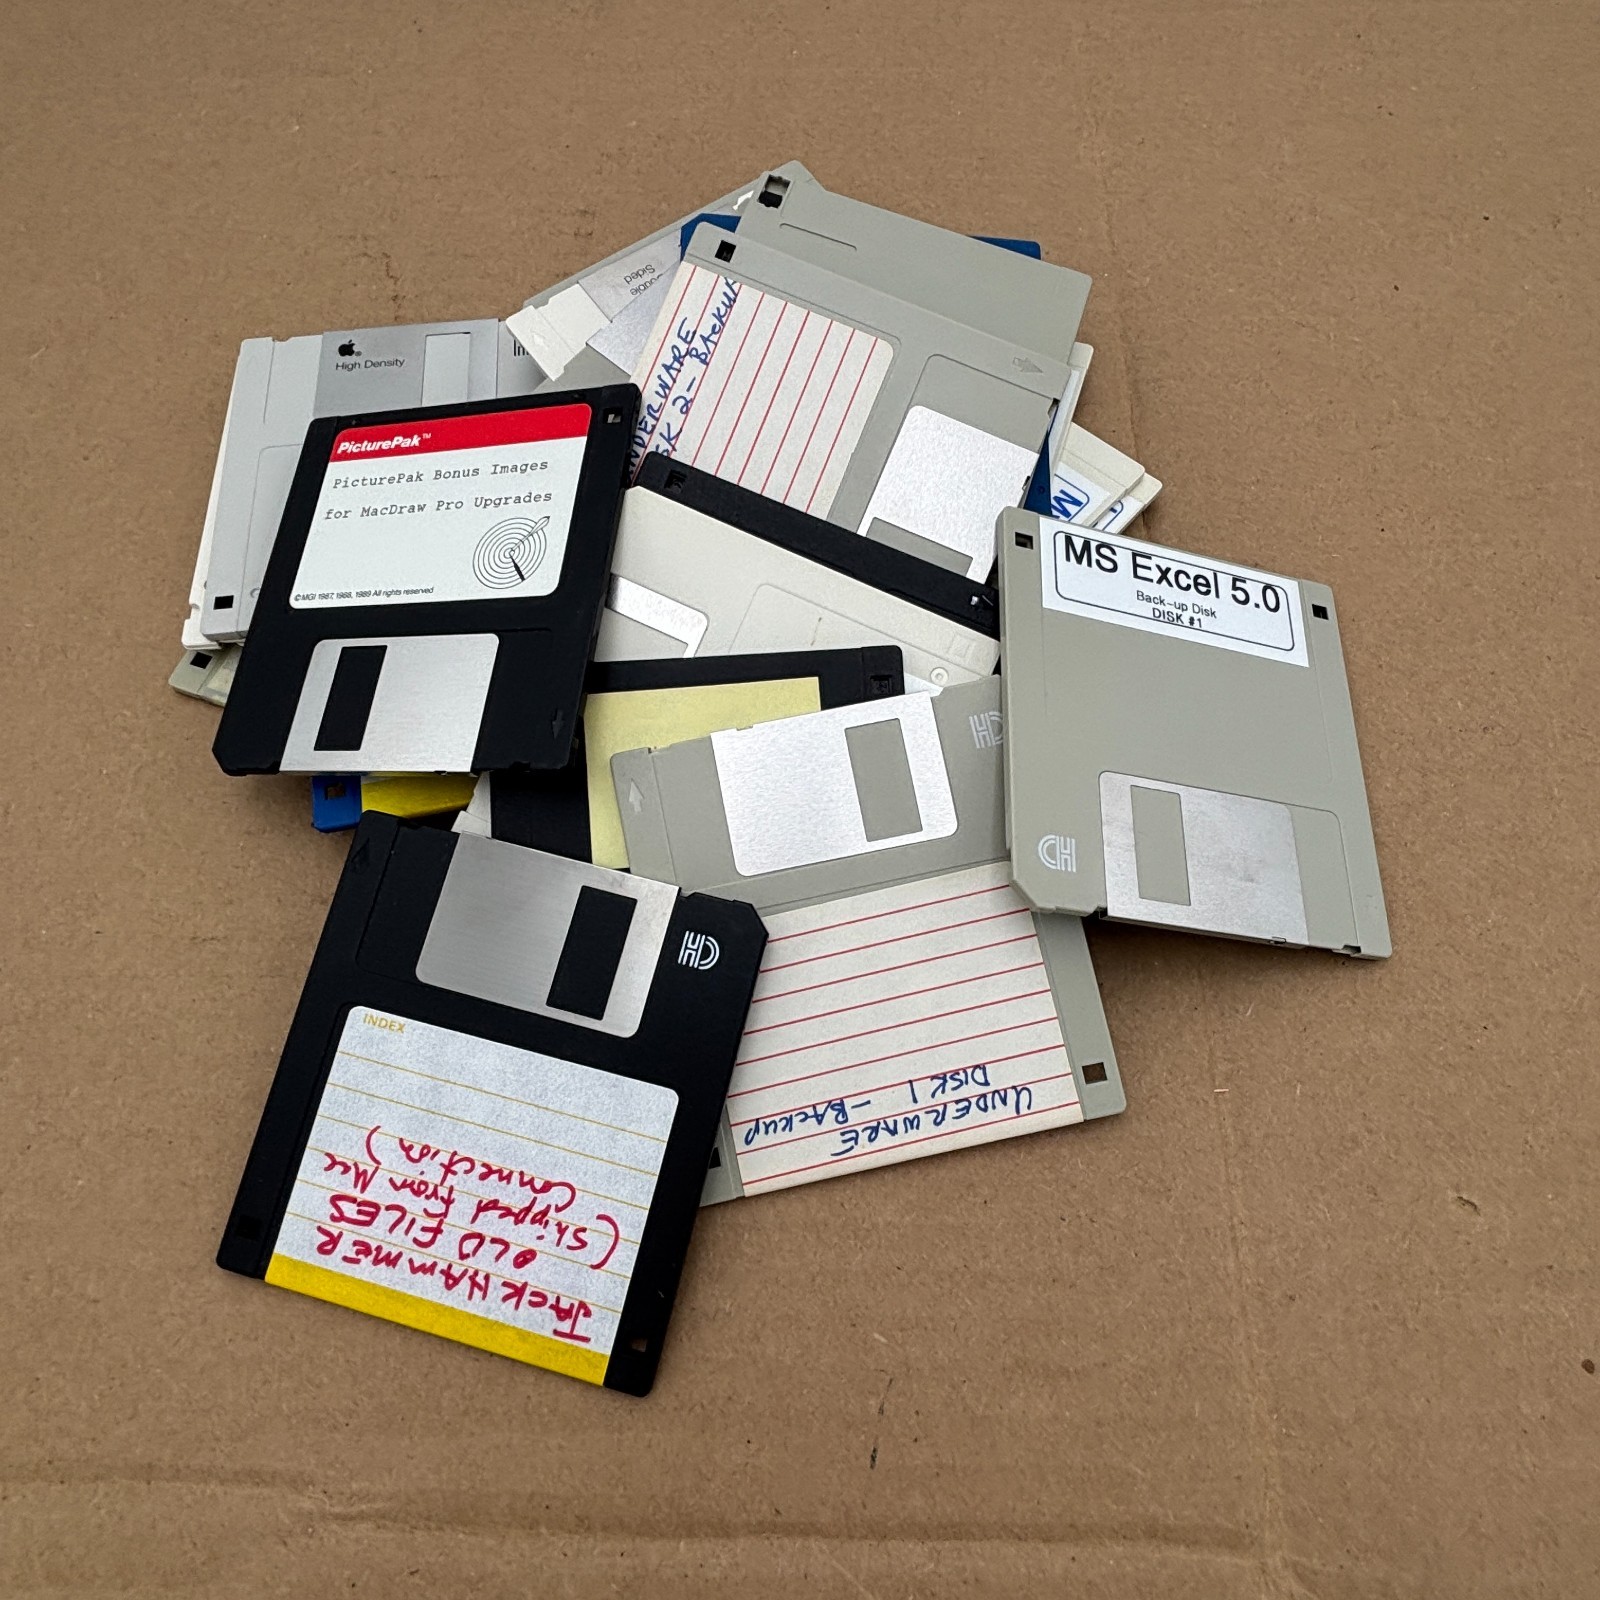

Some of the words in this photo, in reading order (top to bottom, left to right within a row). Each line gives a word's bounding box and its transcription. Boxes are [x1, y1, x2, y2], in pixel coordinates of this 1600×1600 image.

[623, 264, 656, 284] Sided
[629, 273, 664, 296] ouble
[335, 359, 361, 372] High
[364, 358, 406, 370] Density
[627, 317, 697, 479] NDERWARE
[332, 471, 424, 489] PicturePak
[433, 467, 480, 481] Bonus
[490, 460, 549, 475] Images
[324, 508, 352, 520] for
[360, 502, 427, 517] MacDraw
[436, 499, 464, 511] Pro
[474, 491, 552, 509] Upgrades
[1063, 534, 1119, 574] MS
[1131, 551, 1220, 599] Excel
[1231, 576, 1281, 613] 5.0
[372, 589, 383, 597] All
[382, 588, 402, 598] rights
[403, 587, 435, 595] reserved
[1136, 590, 1189, 612] Back-up
[1192, 603, 1217, 619] Disk
[1151, 607, 1185, 625] DISK
[1188, 615, 1203, 628] #1
[678, 930, 720, 971] HD
[363, 1013, 406, 1034] INDEX
[930, 1064, 991, 1099] DISK
[324, 1152, 380, 1194] Mac
[388, 1177, 455, 1219] from
[329, 1194, 444, 1249] FILES
[458, 1232, 538, 1269] OLD
